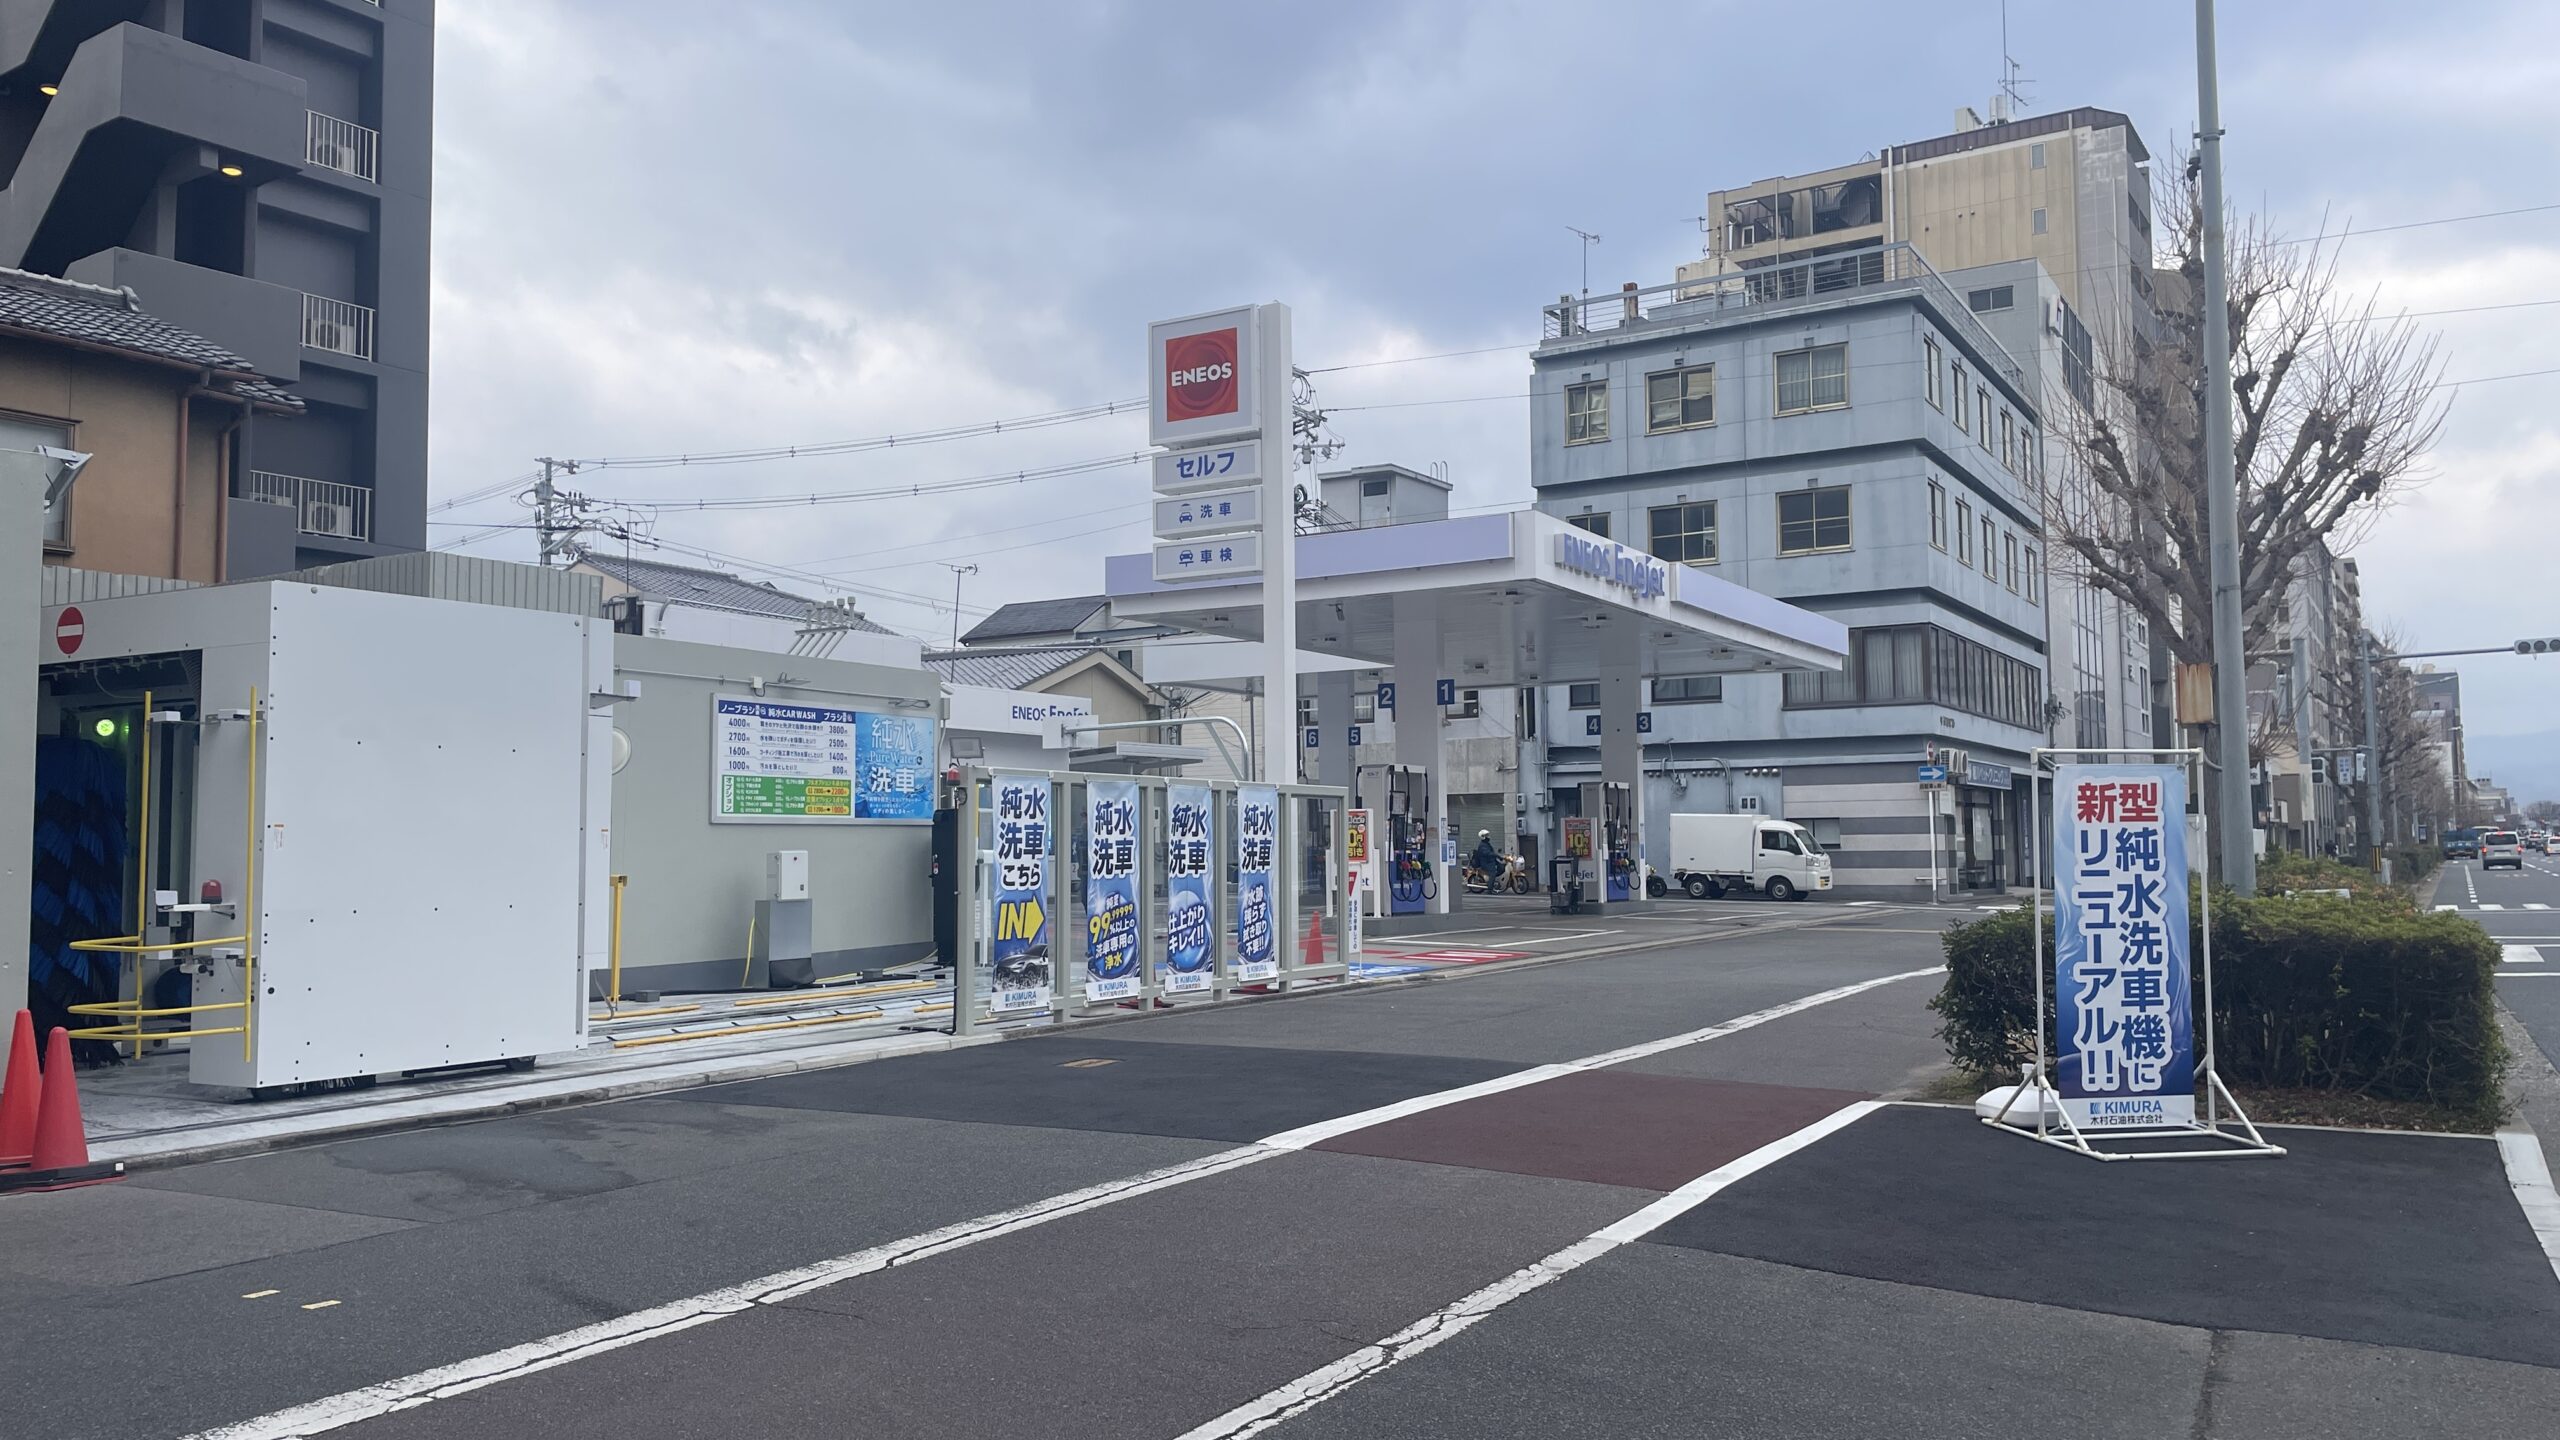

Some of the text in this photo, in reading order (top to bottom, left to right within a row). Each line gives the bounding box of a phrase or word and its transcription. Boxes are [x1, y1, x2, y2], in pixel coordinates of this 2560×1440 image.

[1171, 362, 1232, 387] ENEOS
[1176, 451, 1235, 478] セルフ
[1200, 502, 1231, 518] 洗車
[1200, 547, 1233, 564] 車検
[1563, 533, 1665, 598] ENEOS Enejet
[1381, 687, 1392, 704] 2
[1440, 683, 1449, 701] 1
[1012, 706, 1046, 721] ENEOS
[1588, 718, 1599, 732] 4
[1639, 715, 1649, 730] 3
[872, 719, 914, 750] 純水
[1308, 732, 1317, 745] 6
[1350, 730, 1359, 743] 5
[871, 767, 915, 793] 洗車
[1000, 786, 1045, 819] 純水
[2077, 783, 2159, 823] 新型
[1094, 801, 1133, 835] 純水
[1171, 804, 1207, 837] 純水
[1243, 804, 1274, 836] 純水
[999, 822, 1044, 860] 洗車
[1092, 838, 1134, 875] 洗車
[1169, 839, 1207, 875] 洗車
[1241, 838, 1272, 871] 洗車
[1003, 864, 1041, 886] こちら
[1565, 870, 1594, 879] Eejet
[998, 903, 1026, 940] IN
[1168, 904, 1206, 934] 仕上がり
[1244, 902, 1267, 926] 残らず
[1242, 920, 1268, 943] 拭き取り
[2078, 829, 2119, 1085] リニューアル!!
[2115, 826, 2166, 1085] 純水洗車機に
[1104, 981, 1128, 991] KIMURA
[1180, 974, 1201, 983] KIMURA
[1012, 991, 1036, 1001] KIMURA
[2105, 1101, 2163, 1114] KIMURA
[2090, 1114, 2164, 1126] 木村石油株式会社
